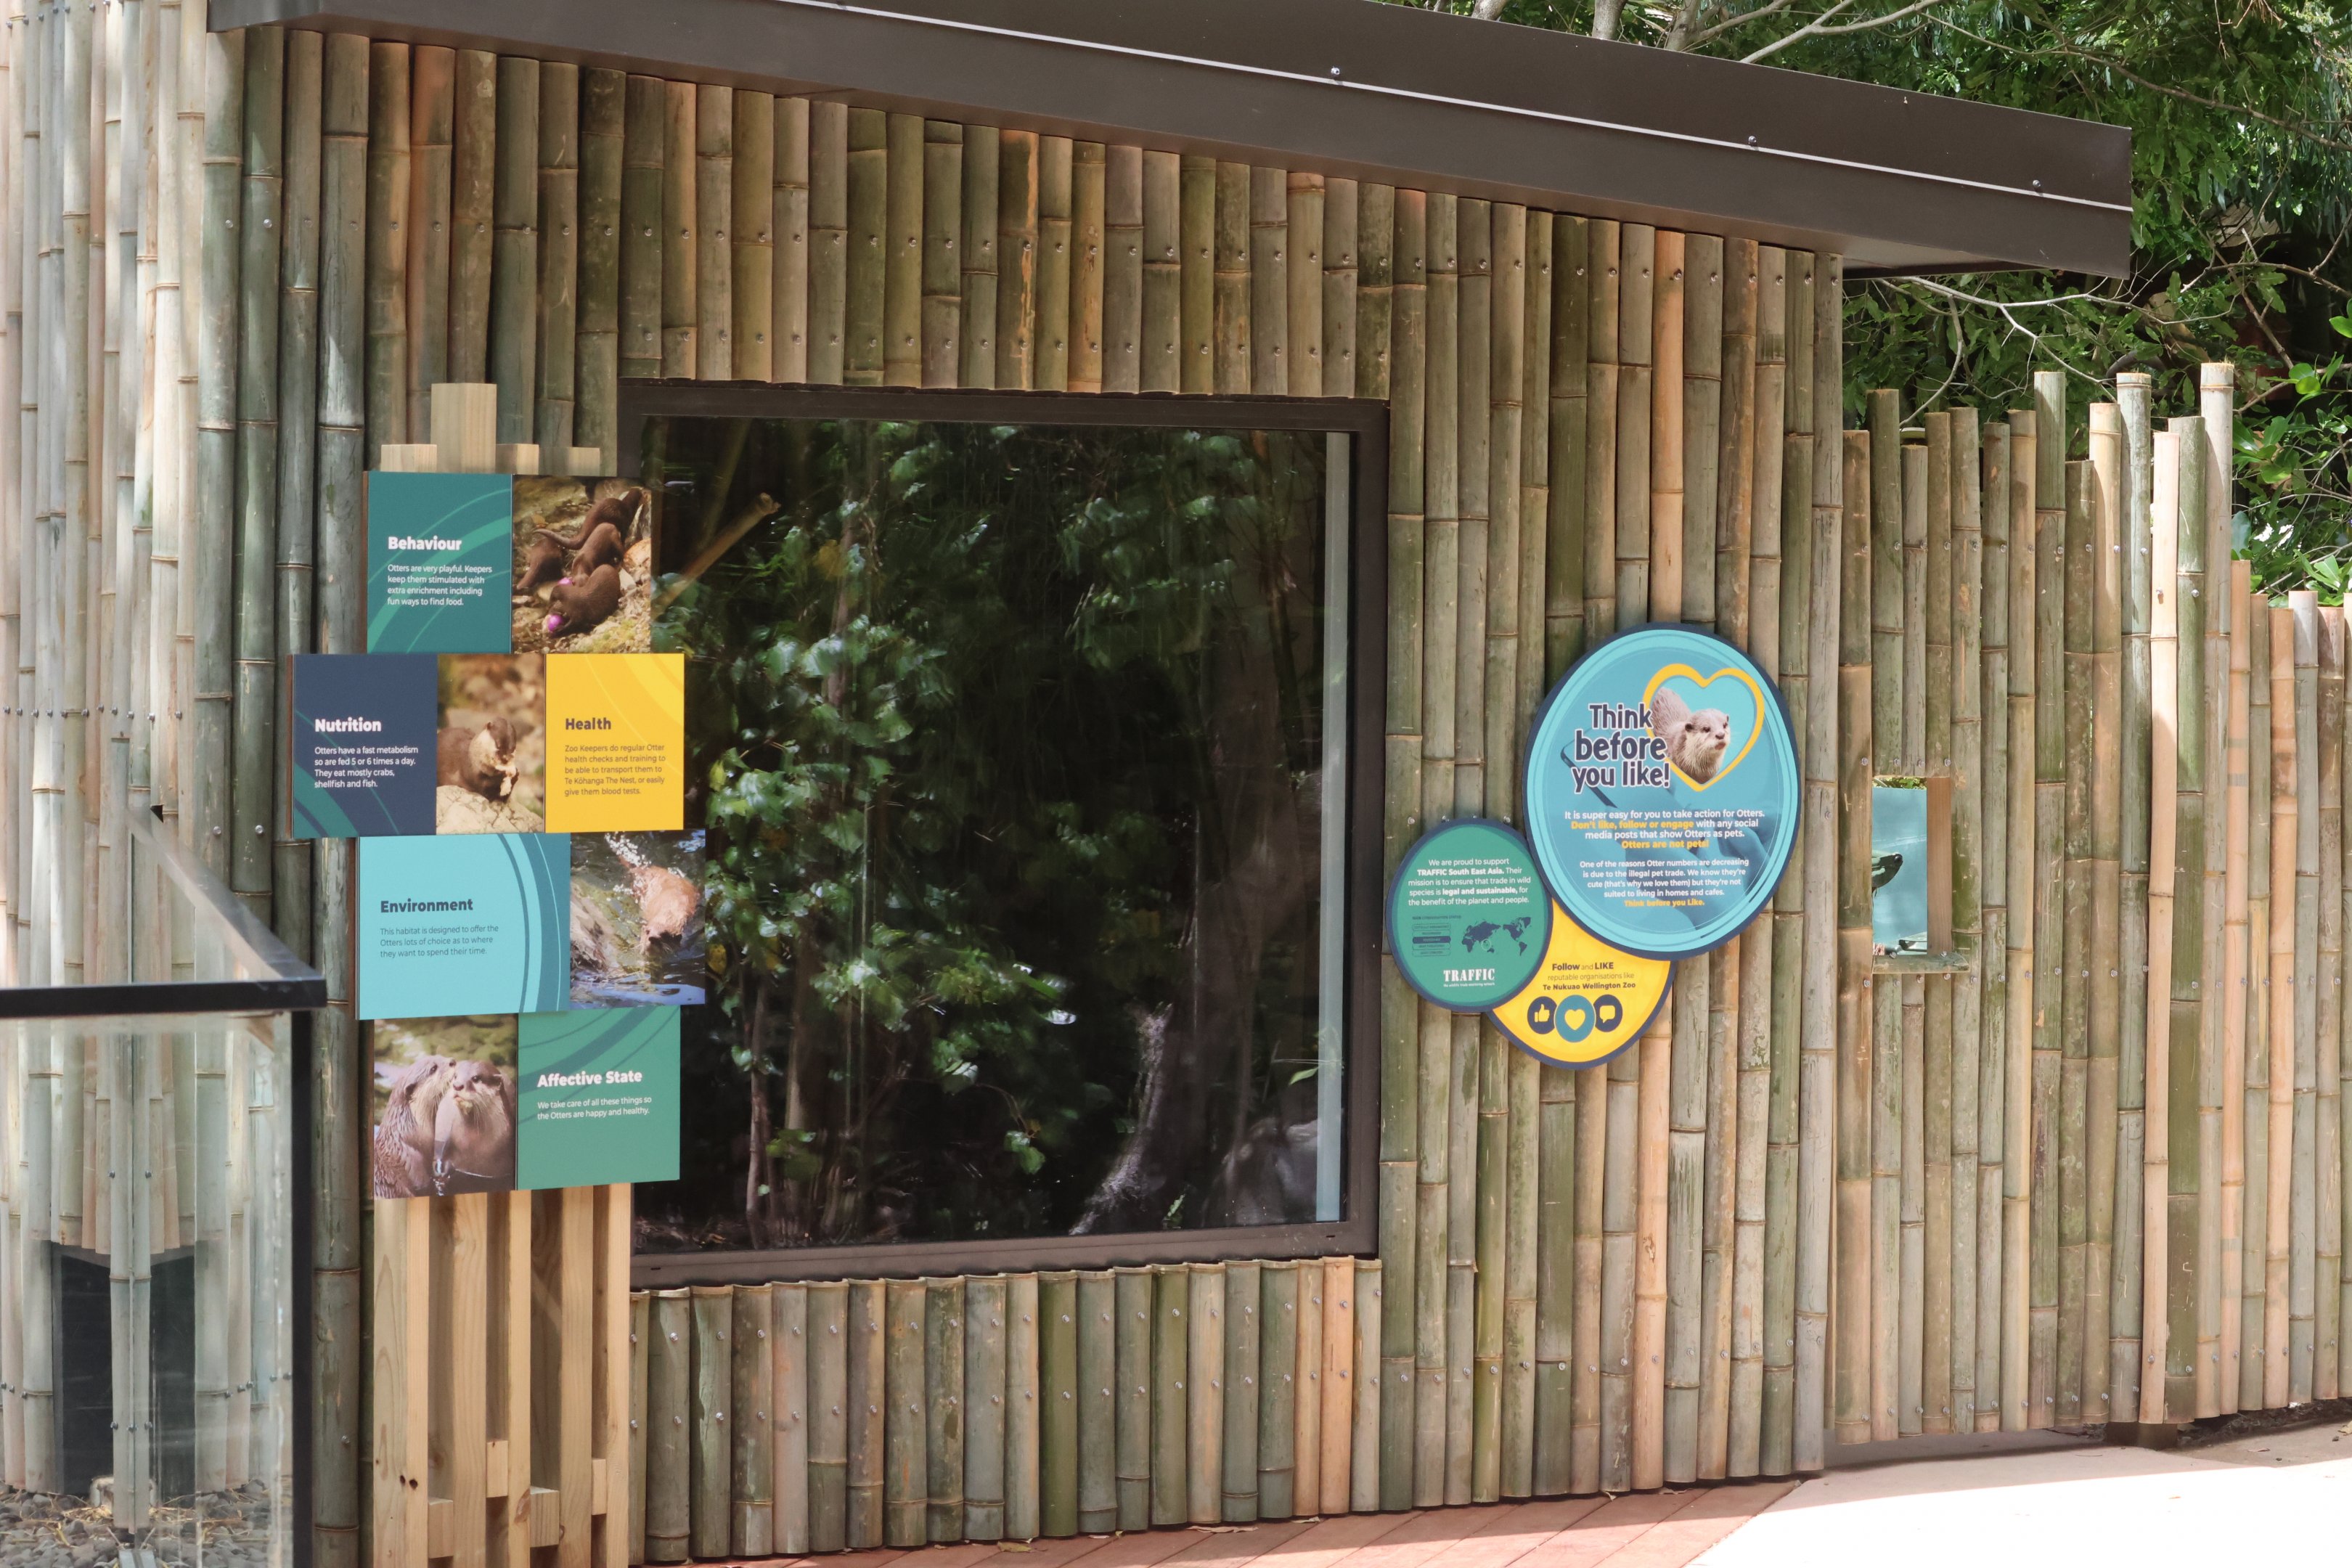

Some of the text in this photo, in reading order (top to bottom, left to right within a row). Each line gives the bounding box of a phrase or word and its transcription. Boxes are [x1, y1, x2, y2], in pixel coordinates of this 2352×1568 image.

[388, 536, 462, 550] Behaviour
[439, 565, 462, 574] playful.
[465, 565, 492, 574] Keepers
[388, 576, 405, 584] keep
[450, 587, 482, 596] including
[1588, 703, 1653, 729] Think
[315, 716, 381, 732] Nutrition
[565, 717, 611, 730] Health
[580, 744, 608, 753] Keepers
[621, 743, 645, 752] regular
[1575, 730, 1667, 761] before
[630, 754, 656, 763] training
[315, 769, 332, 778] They
[348, 769, 372, 777] mostly
[374, 768, 394, 777] crabs,
[1572, 761, 1670, 793] you like!
[315, 780, 345, 788] shellfish
[1598, 821, 1617, 830] like,
[1614, 830, 1638, 840] posts
[1659, 830, 1682, 838] show
[1725, 829, 1744, 838] pets.
[1687, 839, 1710, 849] pets!
[1454, 858, 1473, 867] proud
[1484, 857, 1509, 866] support
[1410, 888, 1434, 897] species
[1442, 887, 1459, 896] legal
[1637, 889, 1655, 898] living
[380, 898, 473, 913] Environment
[1469, 897, 1489, 905] planet
[1506, 896, 1529, 905] people.
[429, 926, 460, 935] designed
[1443, 968, 1495, 981] TRAFFIC
[537, 1071, 642, 1087] Affective State
[621, 1096, 642, 1106] things
[551, 1111, 571, 1119] Otters
[586, 1108, 607, 1118] happy
[624, 1106, 649, 1116] healthy.
